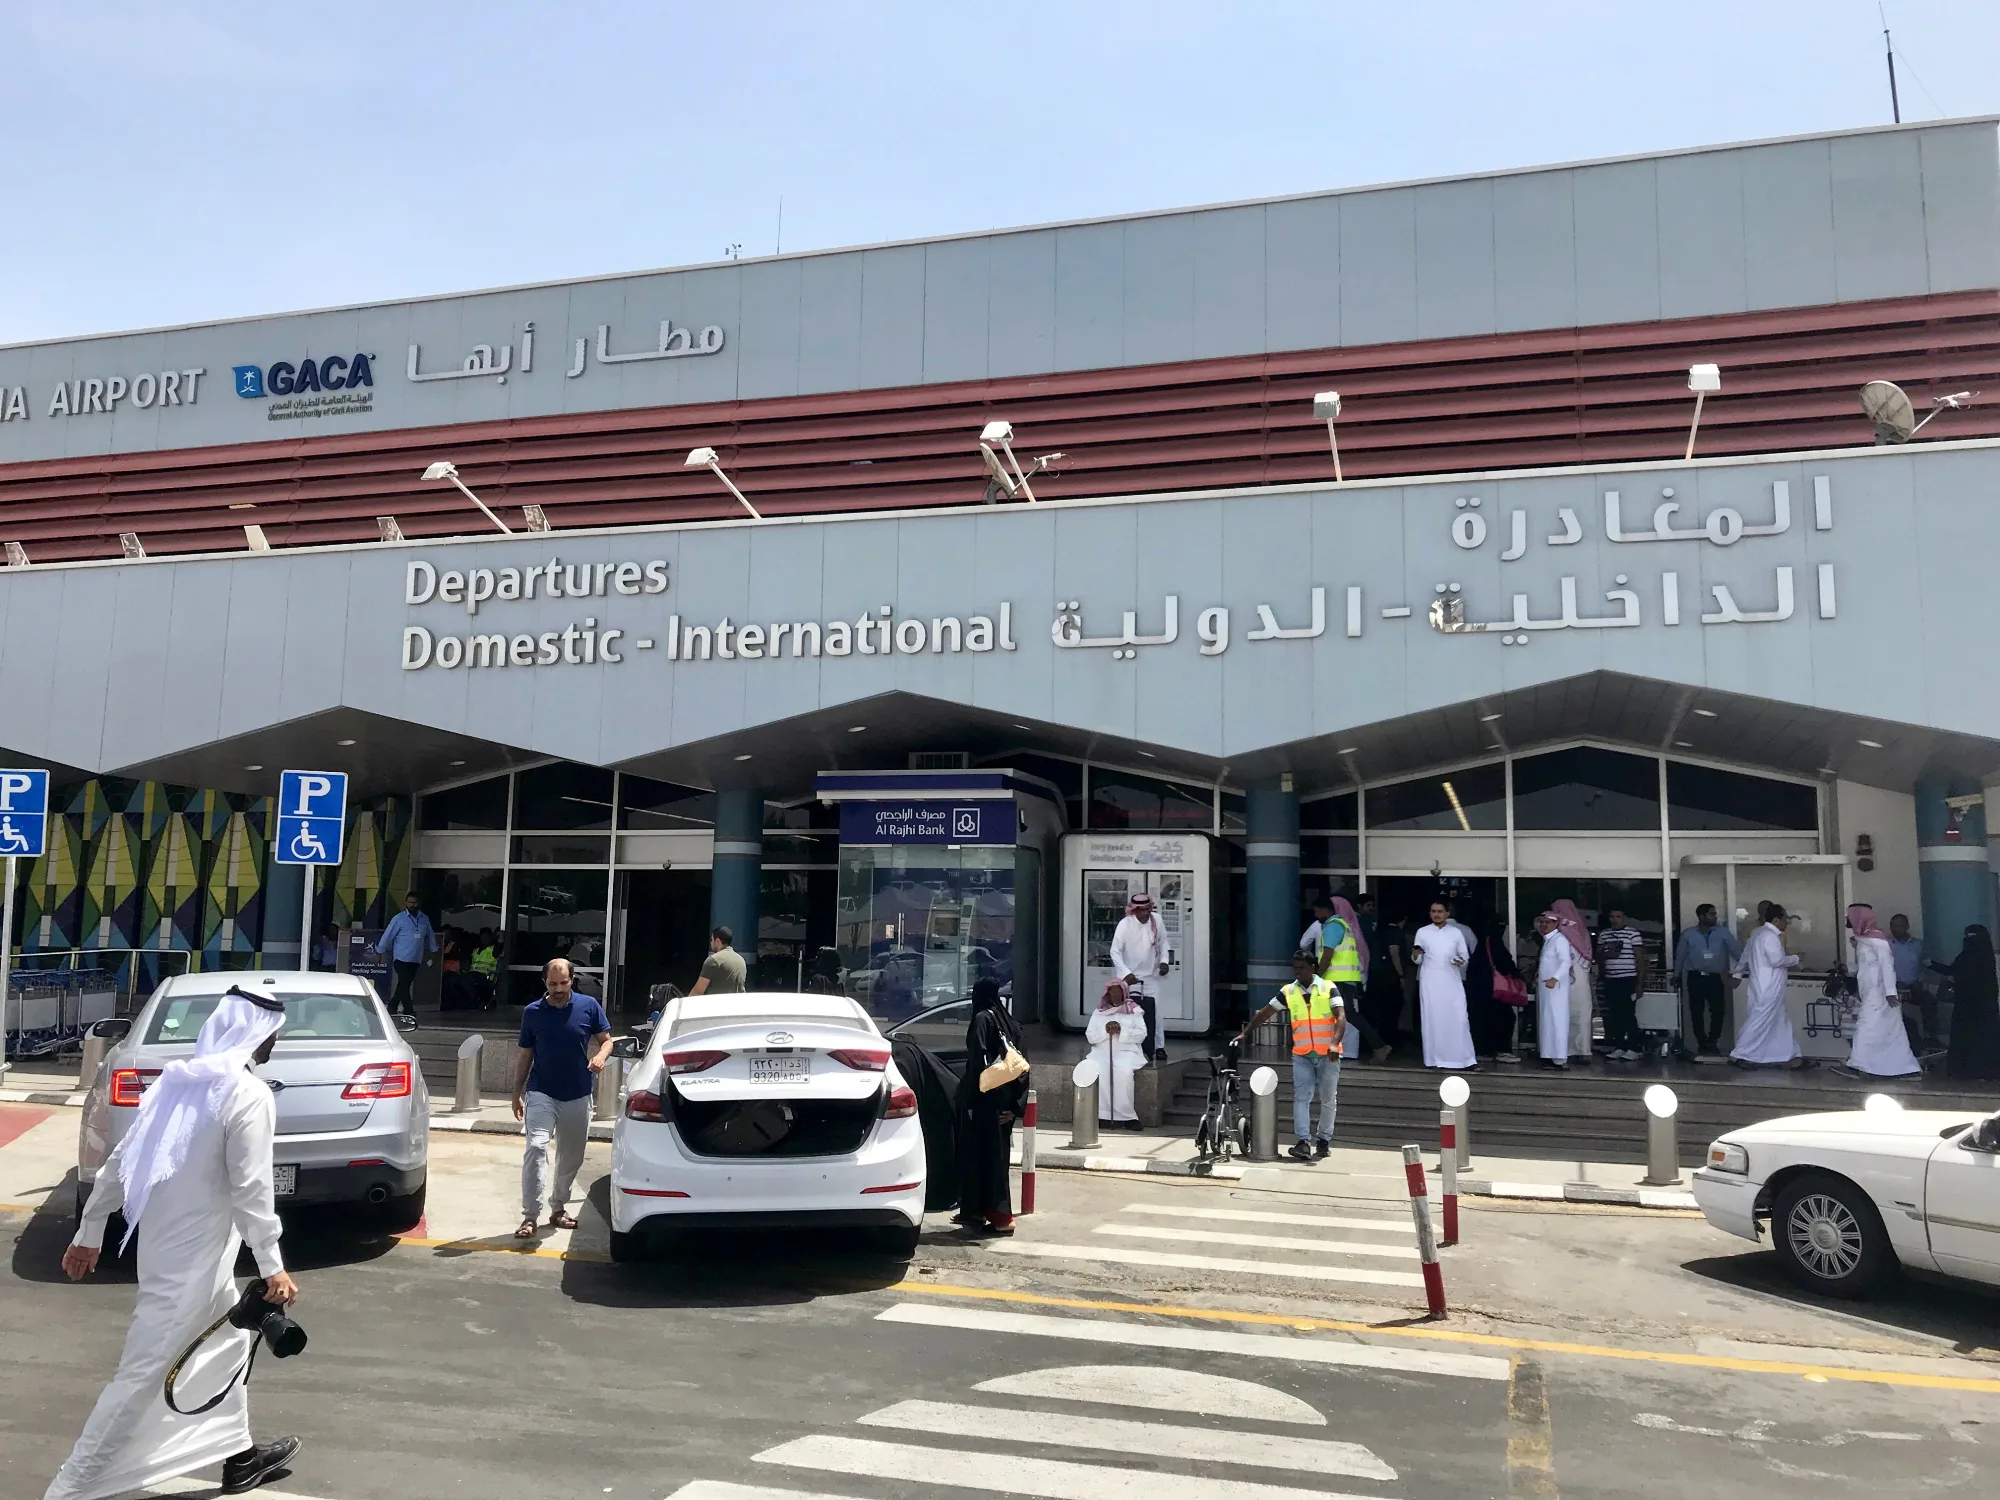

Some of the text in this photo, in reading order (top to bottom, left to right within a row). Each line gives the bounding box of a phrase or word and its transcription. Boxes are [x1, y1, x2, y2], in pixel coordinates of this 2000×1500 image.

[407, 320, 725, 385] مطار أبها
[48, 367, 206, 418] AIRPORT
[267, 353, 373, 396] GACA
[267, 411, 293, 422] General
[293, 409, 322, 419] Authority
[331, 406, 345, 415] Civil
[345, 404, 373, 414] Aviation
[268, 392, 373, 413] الهيئة العامة للطيران المدني
[1451, 475, 1833, 561] المغادرة
[405, 557, 669, 615] Departures
[1428, 564, 1836, 645] الداخلية
[402, 617, 624, 670] Domestic
[668, 601, 1018, 660] International
[1051, 587, 1361, 659] الدولية
[0, 774, 31, 811] P
[293, 776, 331, 815] P
[875, 808, 946, 822] مصرف الراجحي
[875, 824, 945, 837] Al Rajhi Bank
[753, 1071, 780, 1083] 9320
